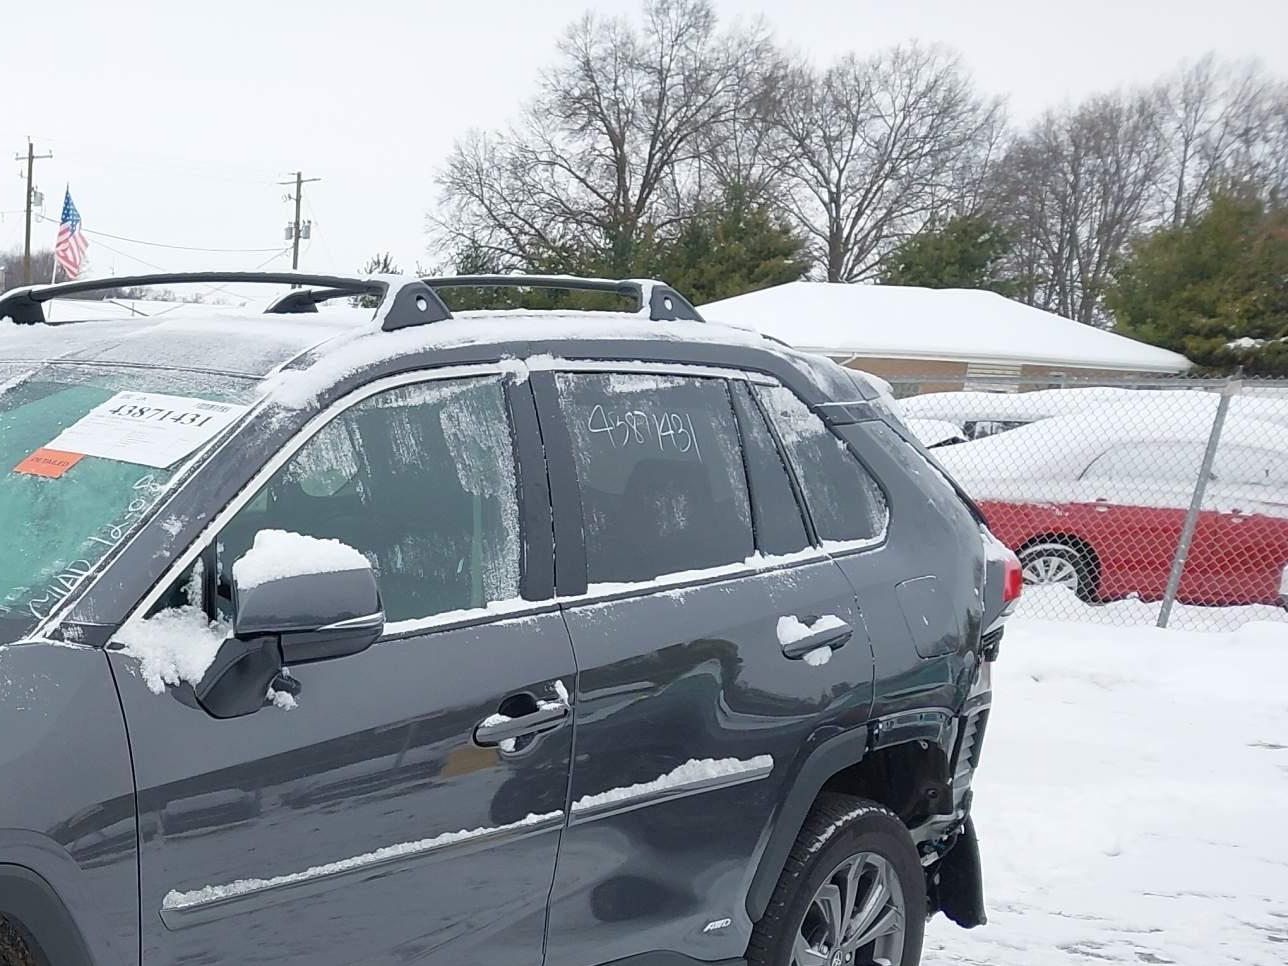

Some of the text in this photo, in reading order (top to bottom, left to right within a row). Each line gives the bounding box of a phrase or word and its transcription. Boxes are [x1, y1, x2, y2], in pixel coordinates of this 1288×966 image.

[109, 403, 214, 428] 43871431
[30, 456, 70, 467] DETAILED
[703, 918, 732, 932] AWD
